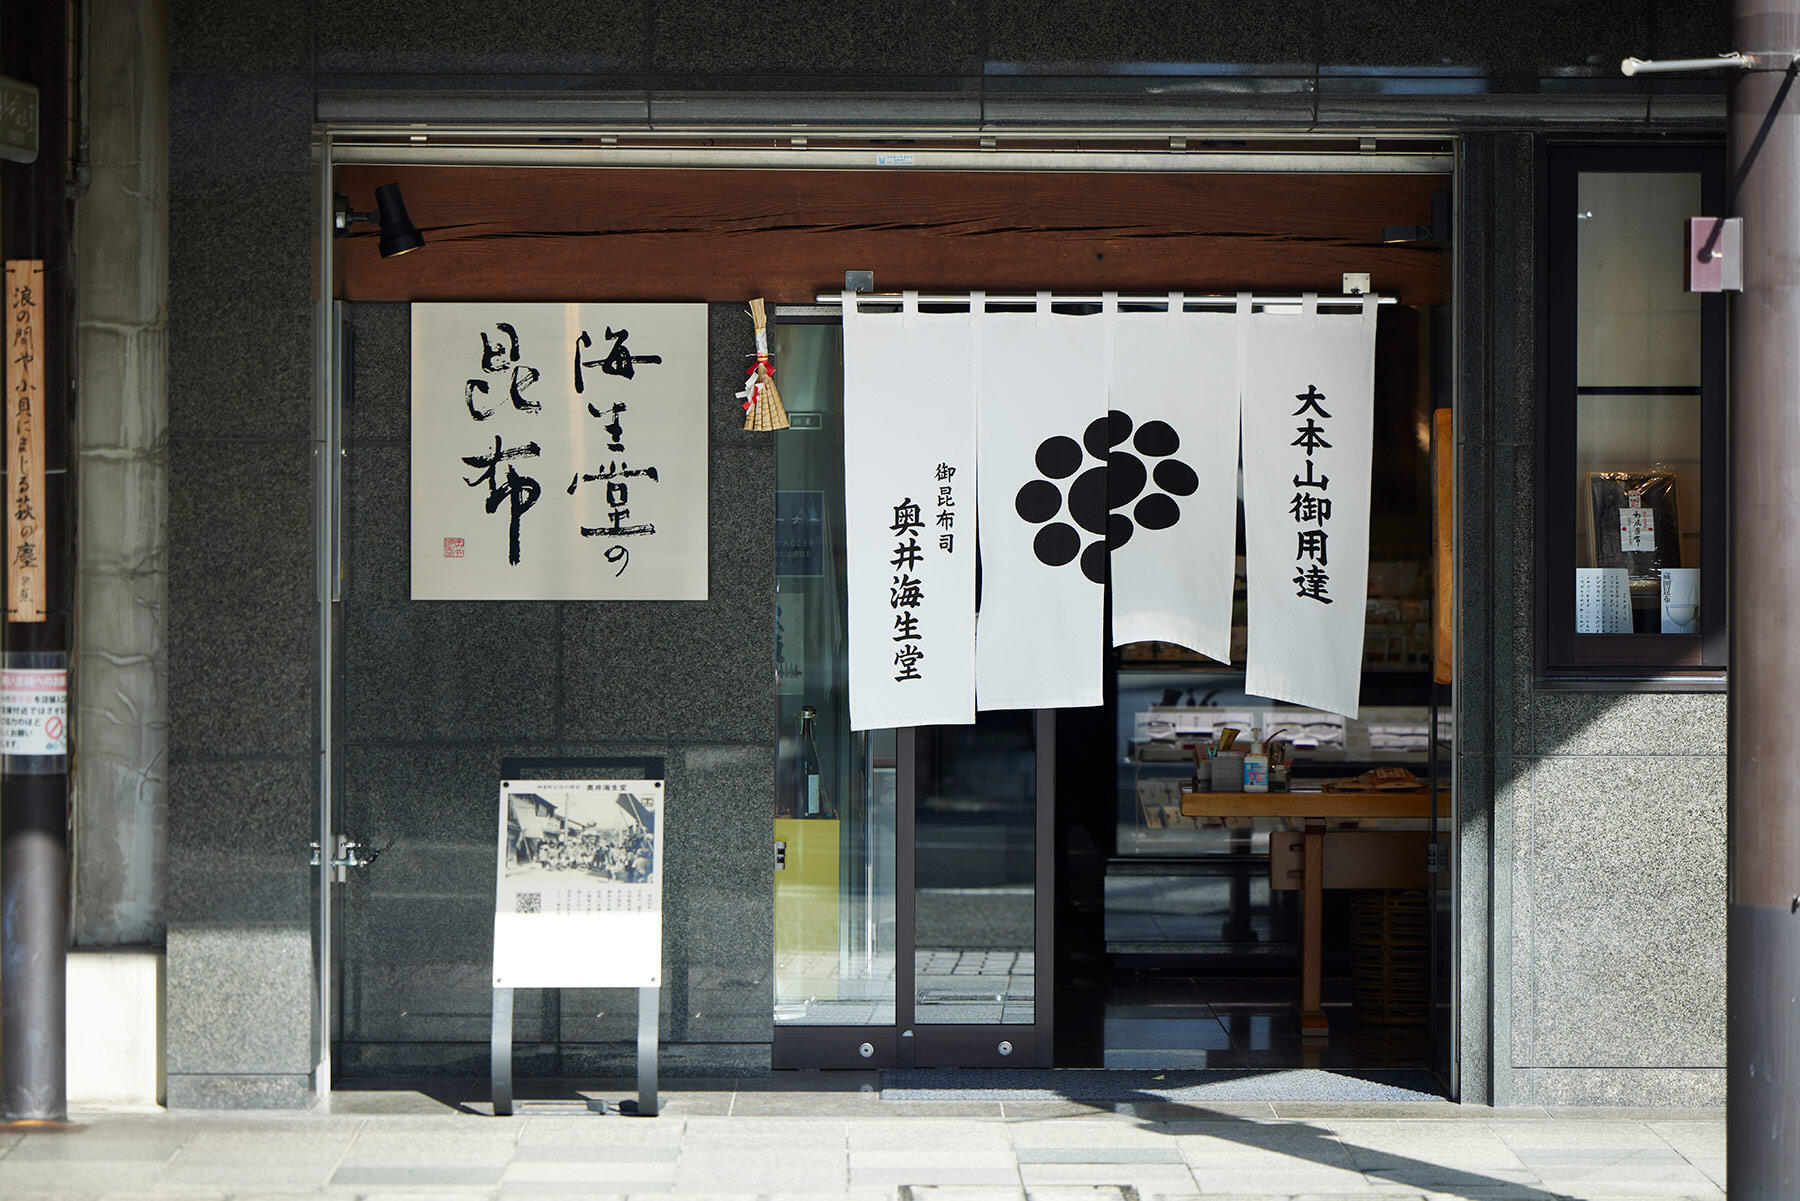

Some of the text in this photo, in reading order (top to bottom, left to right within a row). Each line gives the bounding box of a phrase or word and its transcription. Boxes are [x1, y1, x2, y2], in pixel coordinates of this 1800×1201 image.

[461, 322, 542, 566] 昆布
[566, 326, 662, 577] 海生堂の
[934, 462, 956, 554] 御昆布司
[1289, 384, 1334, 605] 大本山御用達
[889, 497, 926, 683] 奥井海生堂
